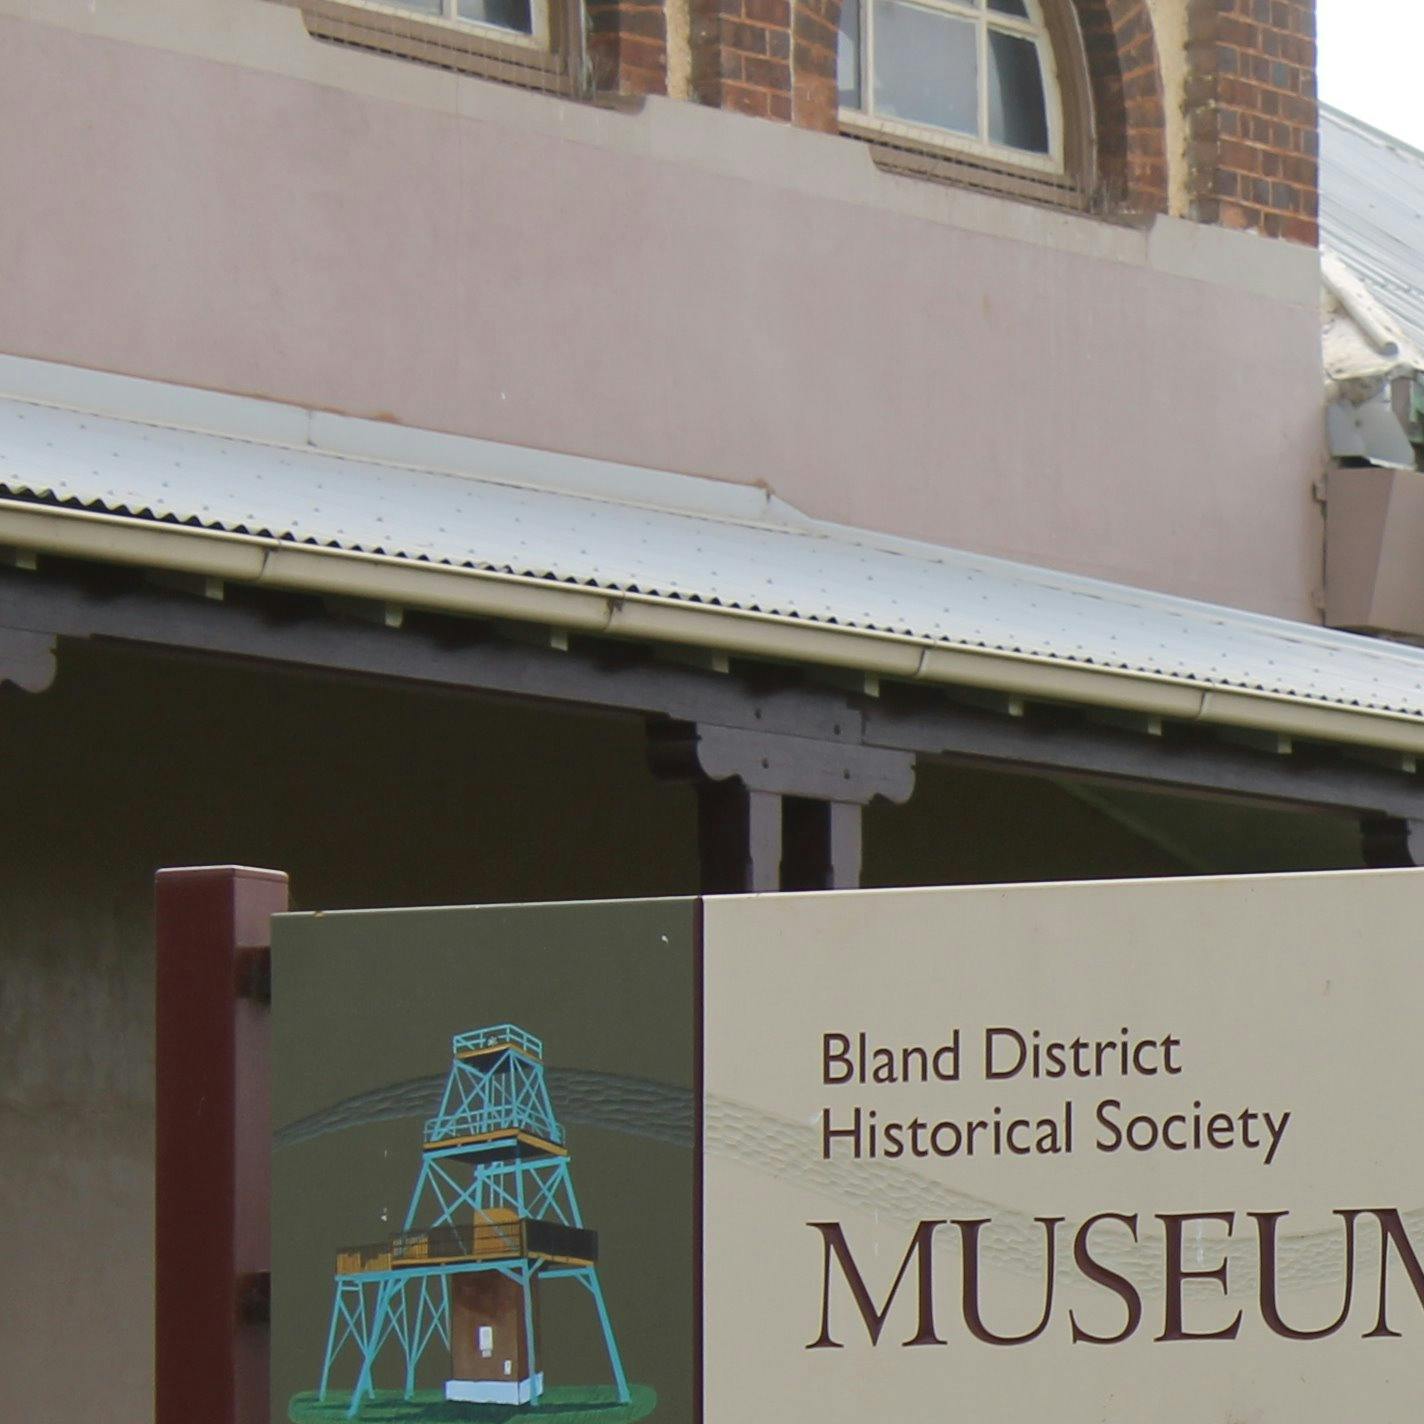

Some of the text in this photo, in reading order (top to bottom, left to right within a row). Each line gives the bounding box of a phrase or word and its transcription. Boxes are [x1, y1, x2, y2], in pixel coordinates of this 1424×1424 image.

[821, 1027, 1183, 1085] Bland District
[822, 1099, 1292, 1165] Historical Society
